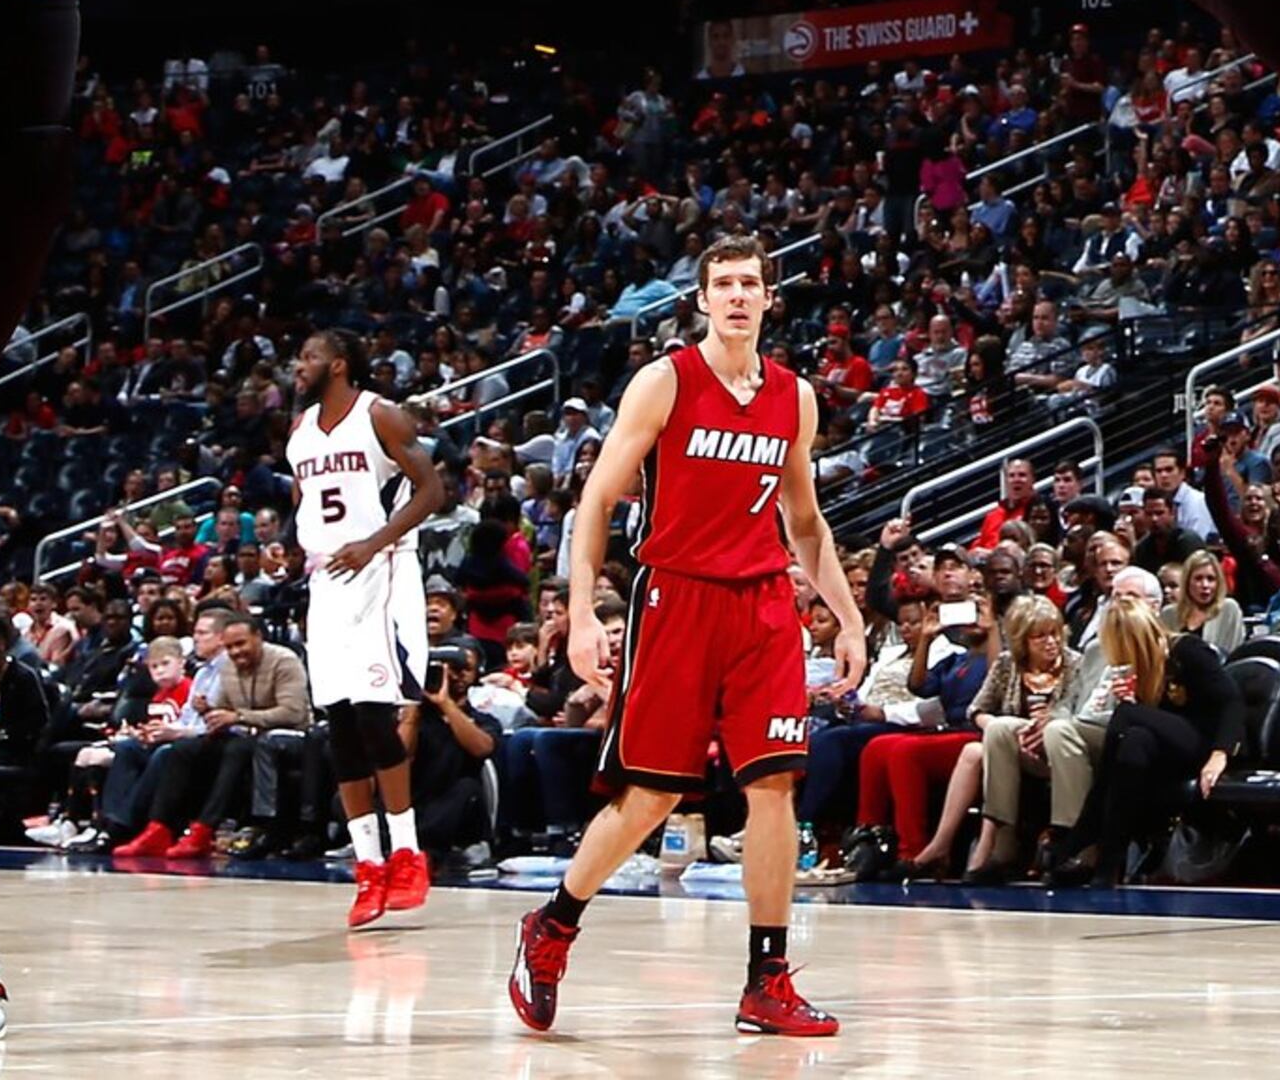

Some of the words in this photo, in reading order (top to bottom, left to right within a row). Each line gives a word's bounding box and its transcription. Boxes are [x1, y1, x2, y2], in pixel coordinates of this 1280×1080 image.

[823, 27, 852, 51] THE
[855, 21, 902, 47] SWISS
[905, 15, 956, 41] GUARD
[685, 428, 790, 468] MIAMI
[320, 487, 347, 524] 5
[750, 474, 780, 514] 7
